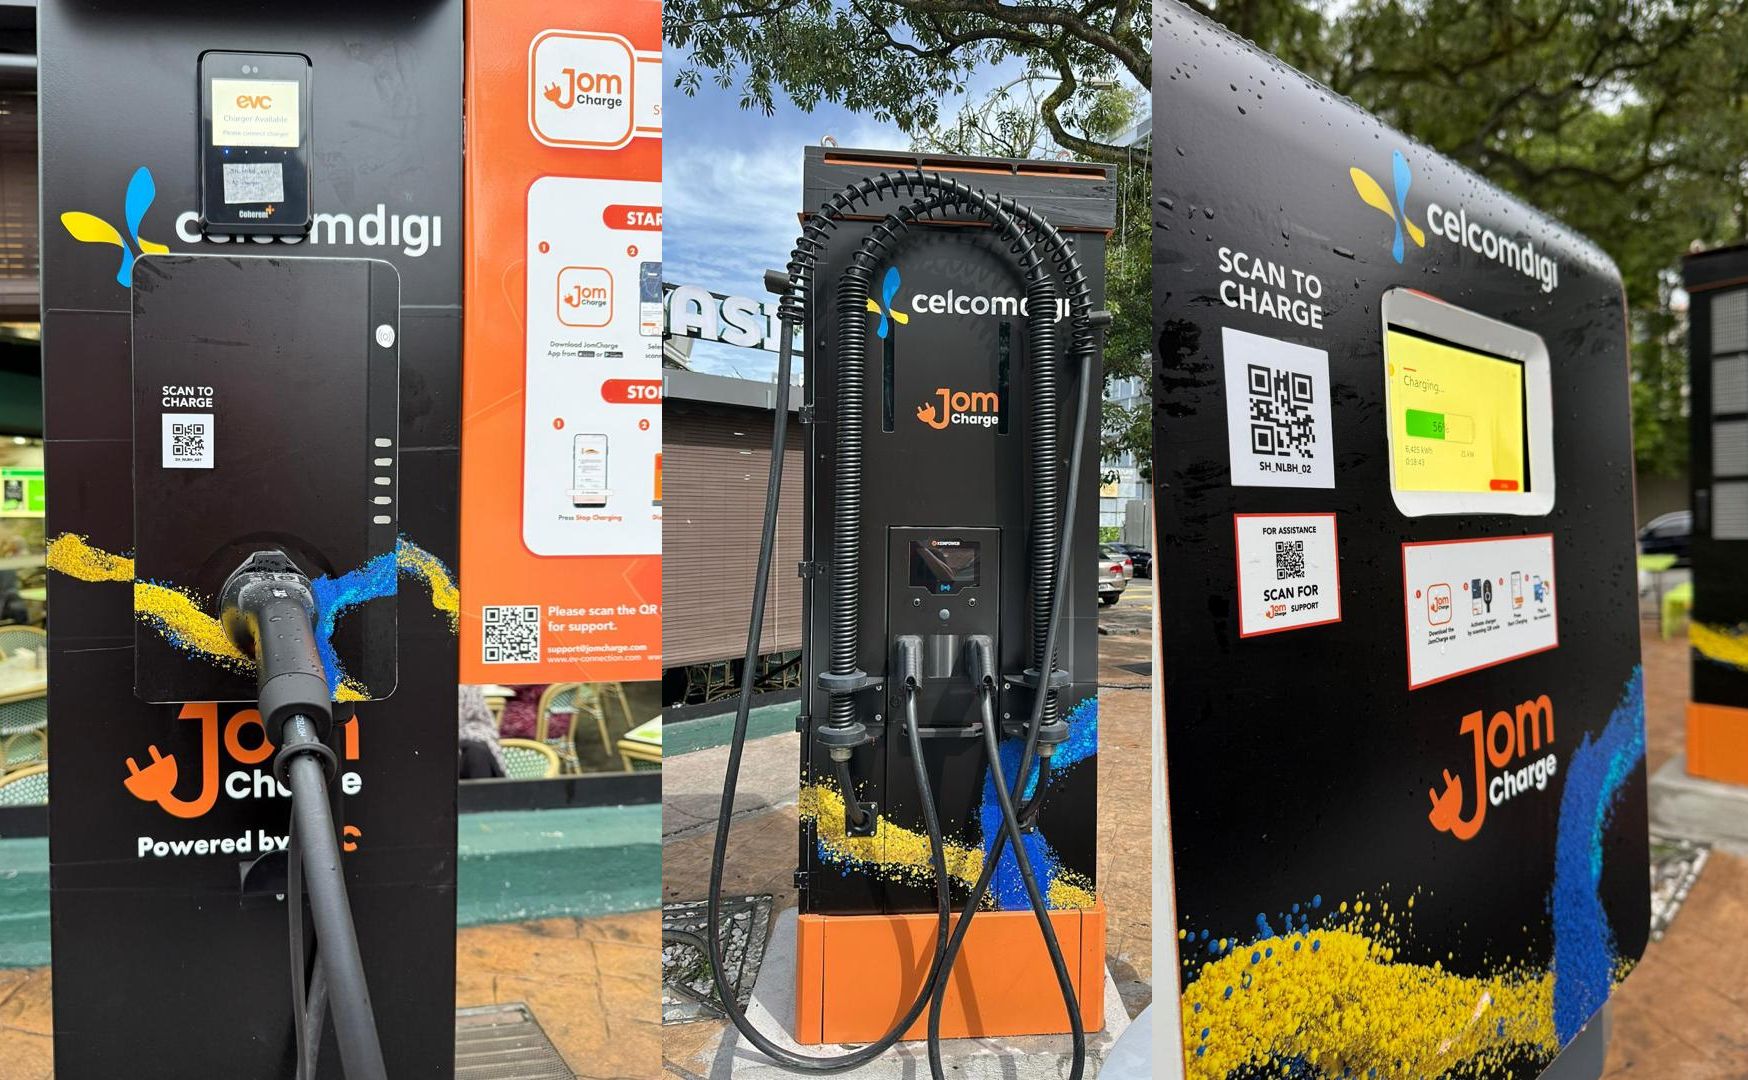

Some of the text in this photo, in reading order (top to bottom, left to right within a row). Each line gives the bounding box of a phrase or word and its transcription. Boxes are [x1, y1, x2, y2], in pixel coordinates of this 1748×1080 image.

[557, 68, 622, 110] Jom
[236, 95, 272, 110] evc
[577, 94, 622, 109] Charge
[1427, 203, 1558, 294] celcomdigi
[1218, 247, 1322, 299] SCAN TO
[570, 285, 606, 308] Jom
[581, 299, 607, 307] Charge
[1220, 280, 1323, 330] CHARGE
[584, 342, 618, 350] JomCharge
[548, 351, 561, 359] App
[562, 350, 577, 358] from
[162, 386, 214, 396] SCAN TO
[162, 397, 213, 408] CHARGE
[928, 388, 999, 430] Jom
[951, 413, 999, 428] Charge
[1432, 420, 1450, 434] 56%
[1259, 461, 1312, 474] SH_NLBH_02
[576, 514, 591, 522] Stop
[592, 514, 622, 523] Charging
[1262, 526, 1316, 535] FOR ASSISTANCE
[1263, 584, 1319, 602] SCAN FOR
[548, 604, 658, 616] Please scan the QR
[1268, 601, 1319, 619] Jom SUPPORT
[548, 621, 617, 633] for support.
[1428, 627, 1448, 637] Download
[547, 644, 648, 654] support@jomcharge.com
[1451, 694, 1555, 841] Jom
[1489, 753, 1558, 806] Charge
[138, 829, 290, 857] Powered by
